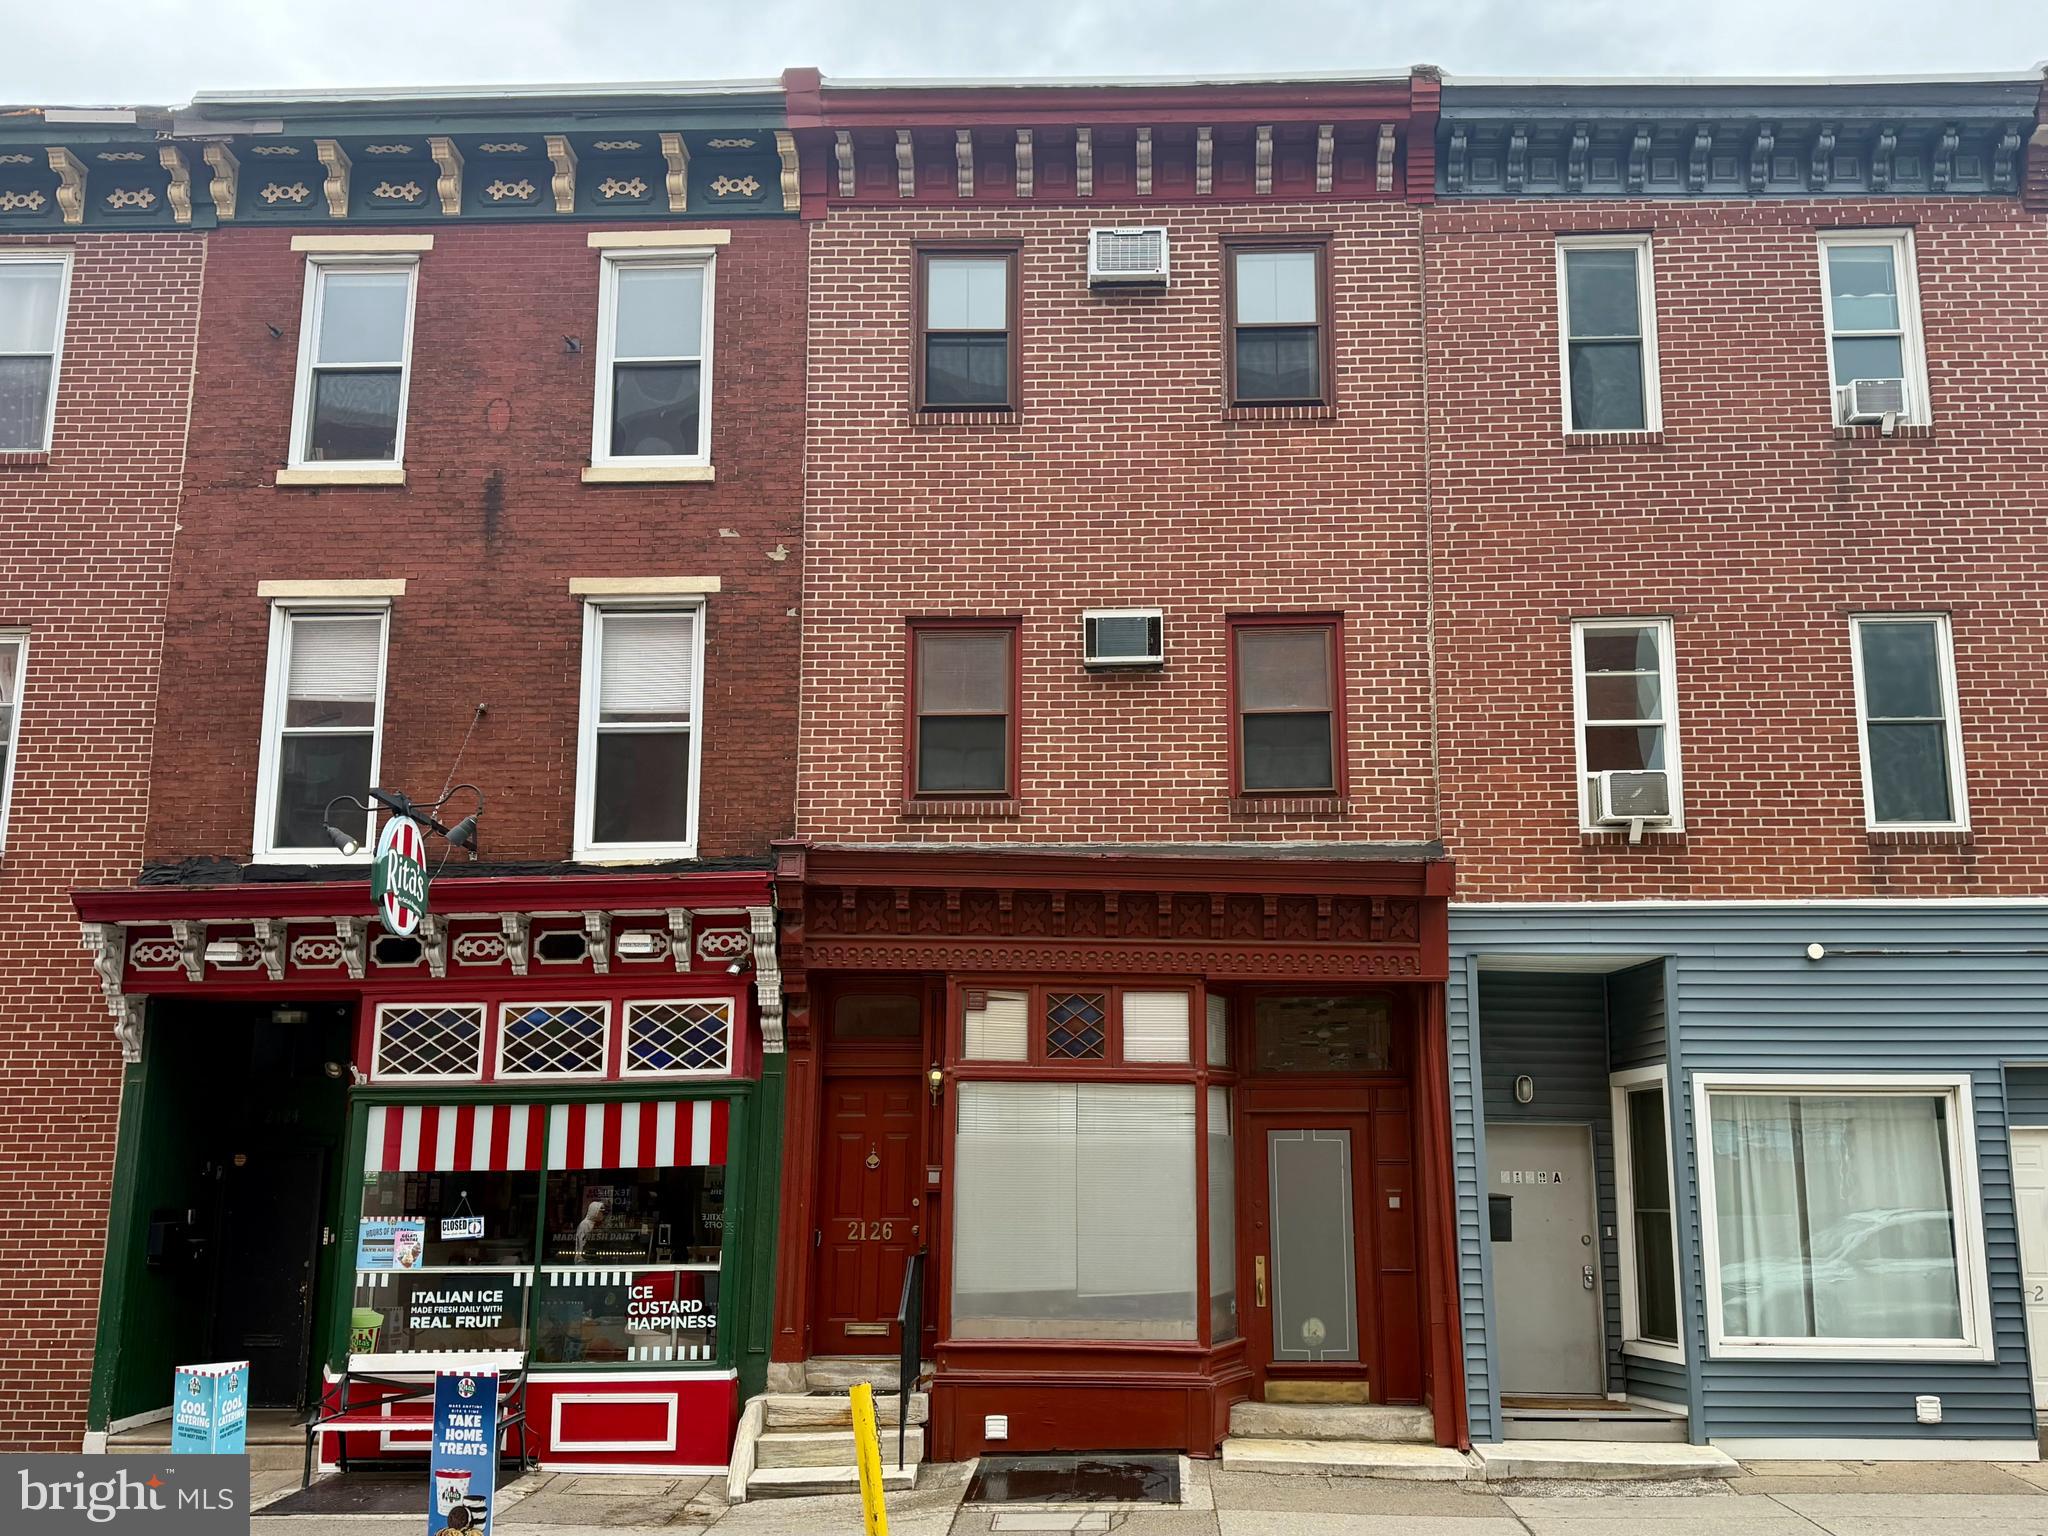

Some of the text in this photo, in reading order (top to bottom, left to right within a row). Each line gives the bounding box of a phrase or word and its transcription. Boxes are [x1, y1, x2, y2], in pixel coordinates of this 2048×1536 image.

[386, 848, 424, 903] Rita's
[442, 1220, 467, 1231] CLOSED
[847, 1221, 893, 1240] 2126
[552, 1233, 577, 1241] MAD
[411, 1290, 503, 1303] ITALIAN ICE
[628, 1285, 654, 1299] ICE
[2034, 1285, 2044, 1302] 2
[410, 1306, 432, 1314] MADE
[459, 1305, 481, 1313] DAILY
[482, 1305, 503, 1313] WITH
[627, 1299, 703, 1315] CUSTARD
[410, 1315, 502, 1329] REAL FRUIT
[627, 1315, 717, 1330] HAPPINESS
[180, 1399, 207, 1416] COOL
[222, 1394, 242, 1414] COOL
[176, 1413, 210, 1428] CATERING
[218, 1407, 245, 1426] CATERING
[448, 1414, 482, 1428] TAKE
[445, 1429, 483, 1442] HOME
[439, 1443, 487, 1456] TREATS
